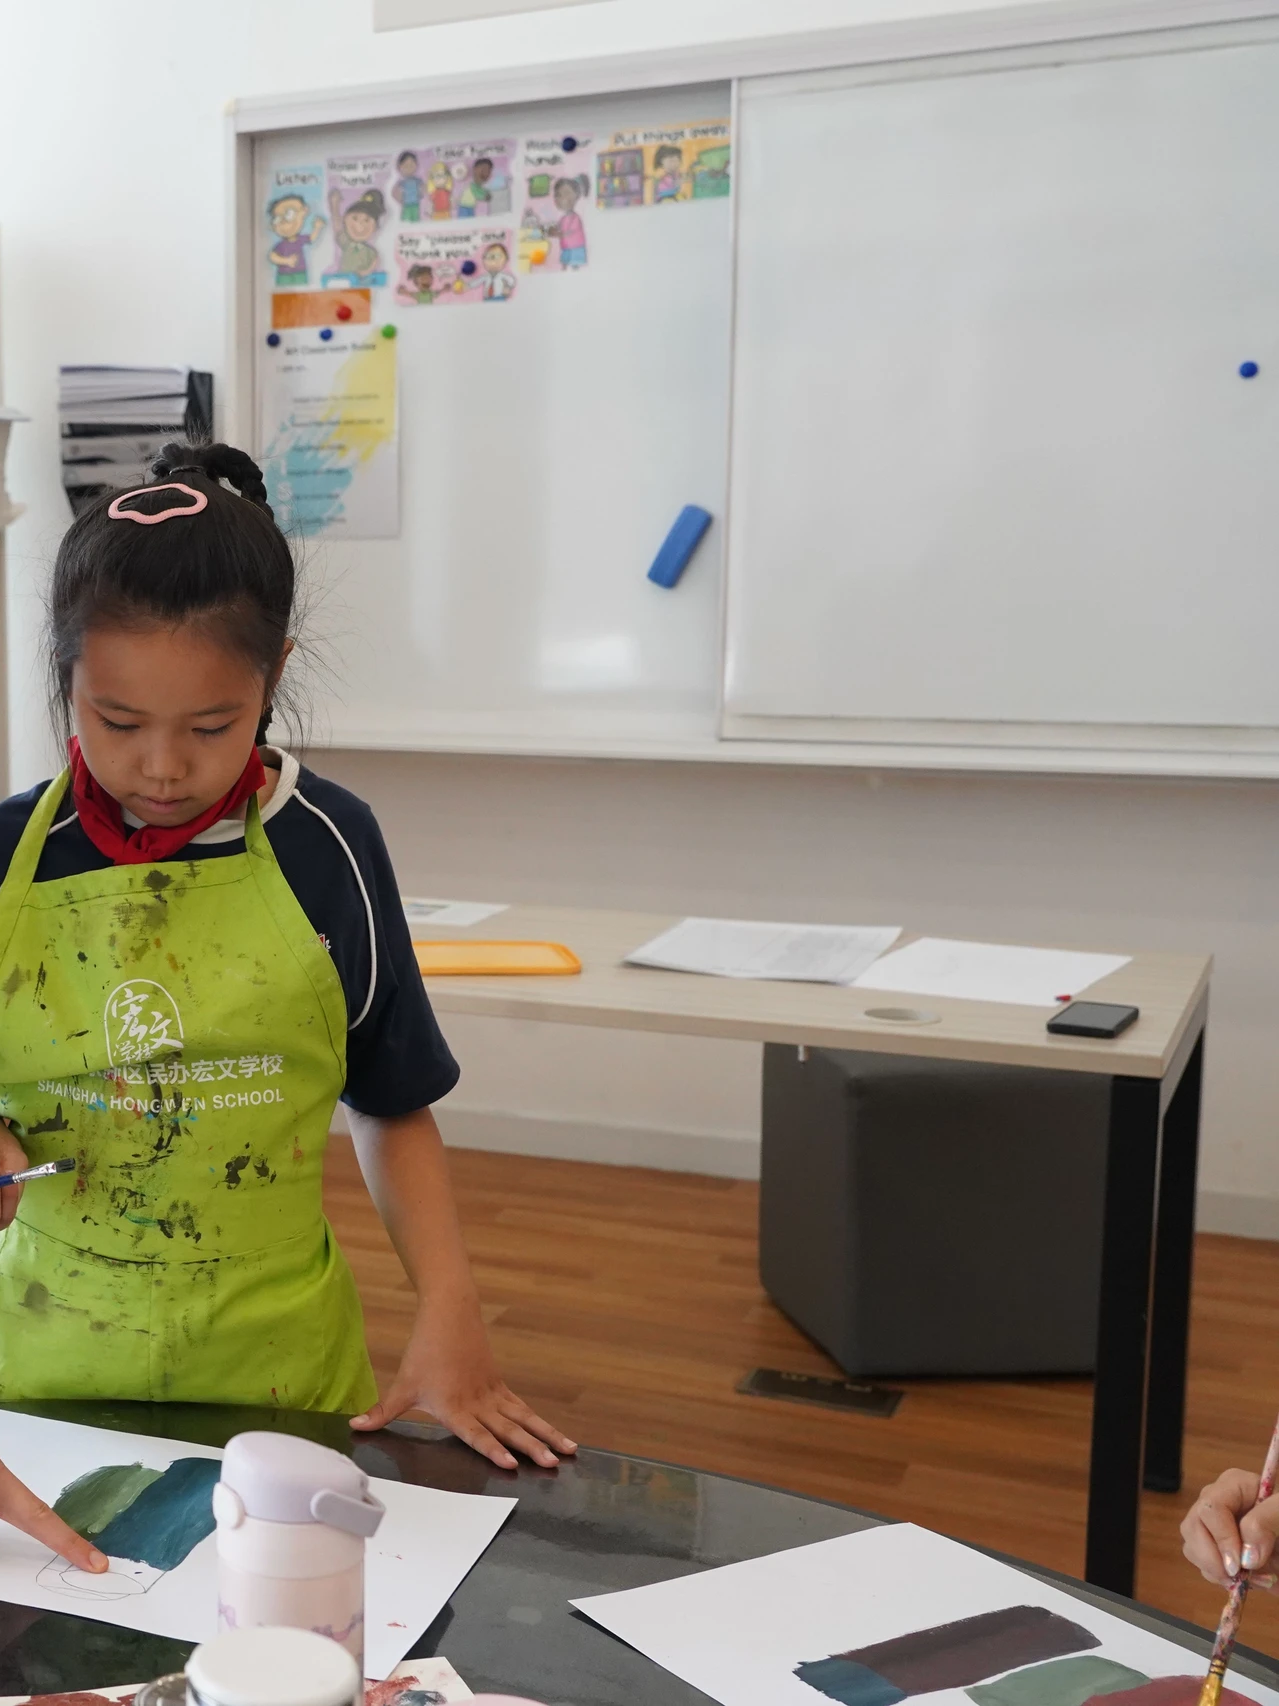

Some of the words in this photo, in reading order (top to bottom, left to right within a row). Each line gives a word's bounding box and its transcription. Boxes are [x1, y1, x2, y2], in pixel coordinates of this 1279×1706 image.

[643, 129, 685, 144] things
[110, 1095, 206, 1113] HONGWEN
[212, 1088, 285, 1109] SCHOOL
